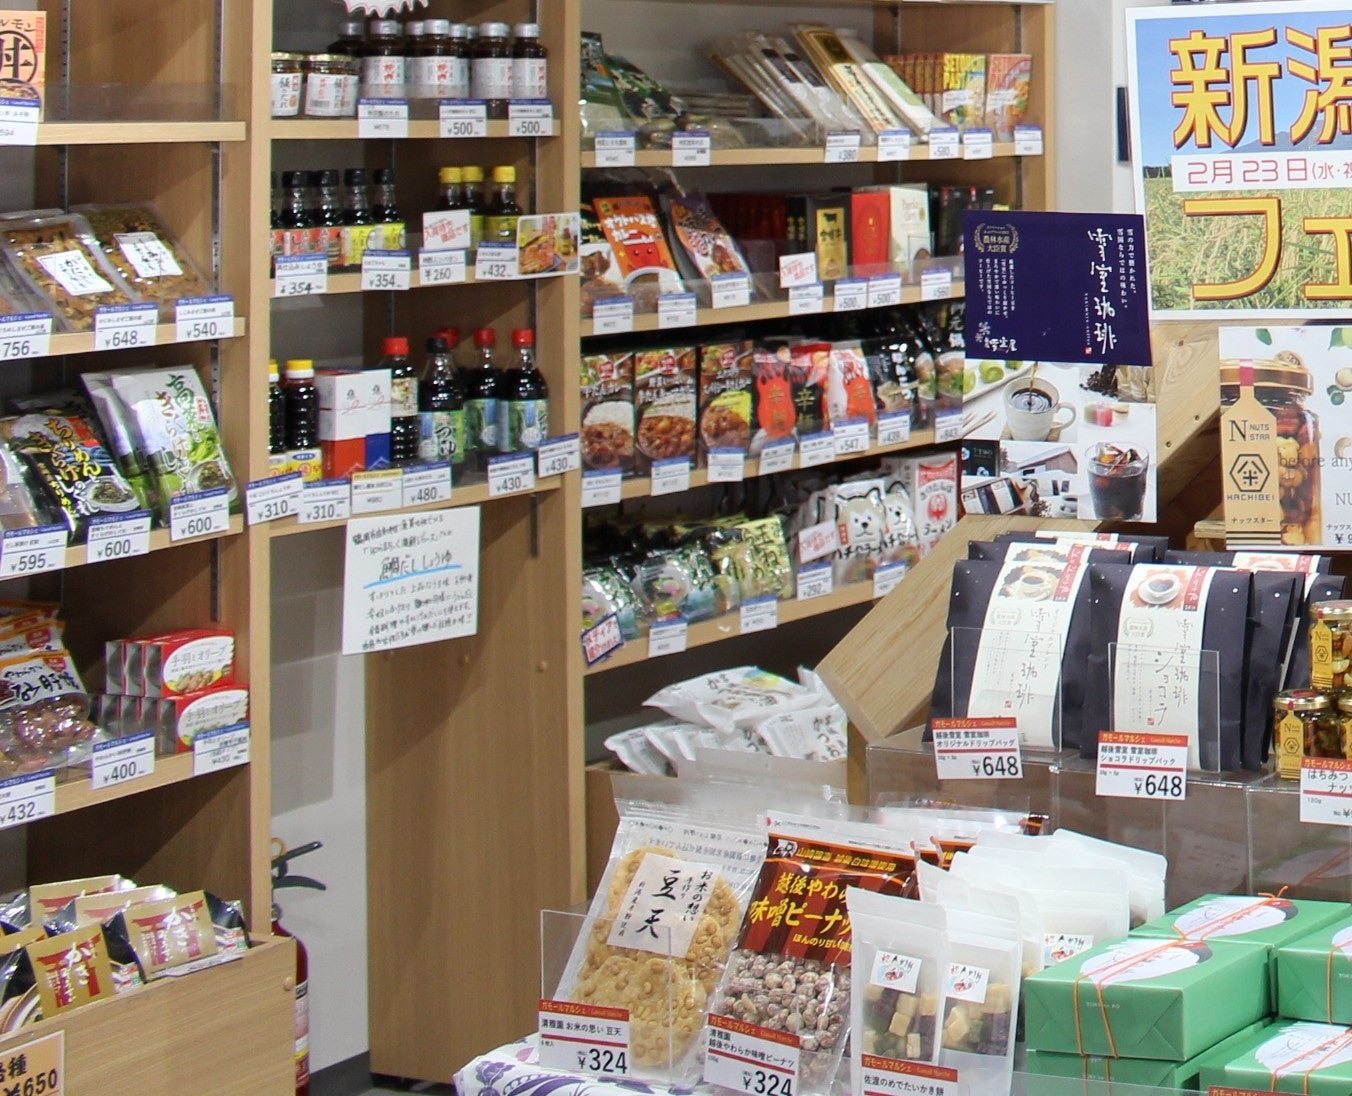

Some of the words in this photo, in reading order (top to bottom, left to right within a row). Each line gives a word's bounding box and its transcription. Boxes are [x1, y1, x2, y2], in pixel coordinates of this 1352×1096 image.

[1086, 227, 1118, 355] 雪室珈琲
[105, 330, 139, 348] ¥648
[186, 321, 218, 339] ¥540
[1228, 419, 1249, 443] N
[1249, 423, 1271, 432] NUTS
[1279, 455, 1326, 469] before
[181, 516, 213, 535] ¥600
[1230, 516, 1274, 526] ナッツスター
[97, 538, 132, 559] ¥600
[10, 552, 46, 573] ¥595
[934, 719, 978, 728] ガモールマルシェ
[1102, 733, 1147, 744] ガモールマルシェ
[104, 761, 137, 785] ¥400
[972, 755, 1019, 777] ¥648
[1304, 759, 1351, 770] ガモールマルシェ
[1134, 773, 1183, 797] ¥648
[1307, 769, 1349, 782] はちみつ
[635, 869, 682, 940] 豆天
[541, 1000, 587, 1015] ガモールマルシェ
[566, 1021, 604, 1034] お米の思い
[606, 1026, 622, 1036] 豆天
[709, 1014, 756, 1035] ガモールマルシェ
[576, 1048, 628, 1074] ¥324
[864, 1056, 912, 1073] ガモールマルシェ
[743, 1069, 793, 1096] ¥324
[863, 1074, 945, 1096] 佐渡のめでたいかき餅
